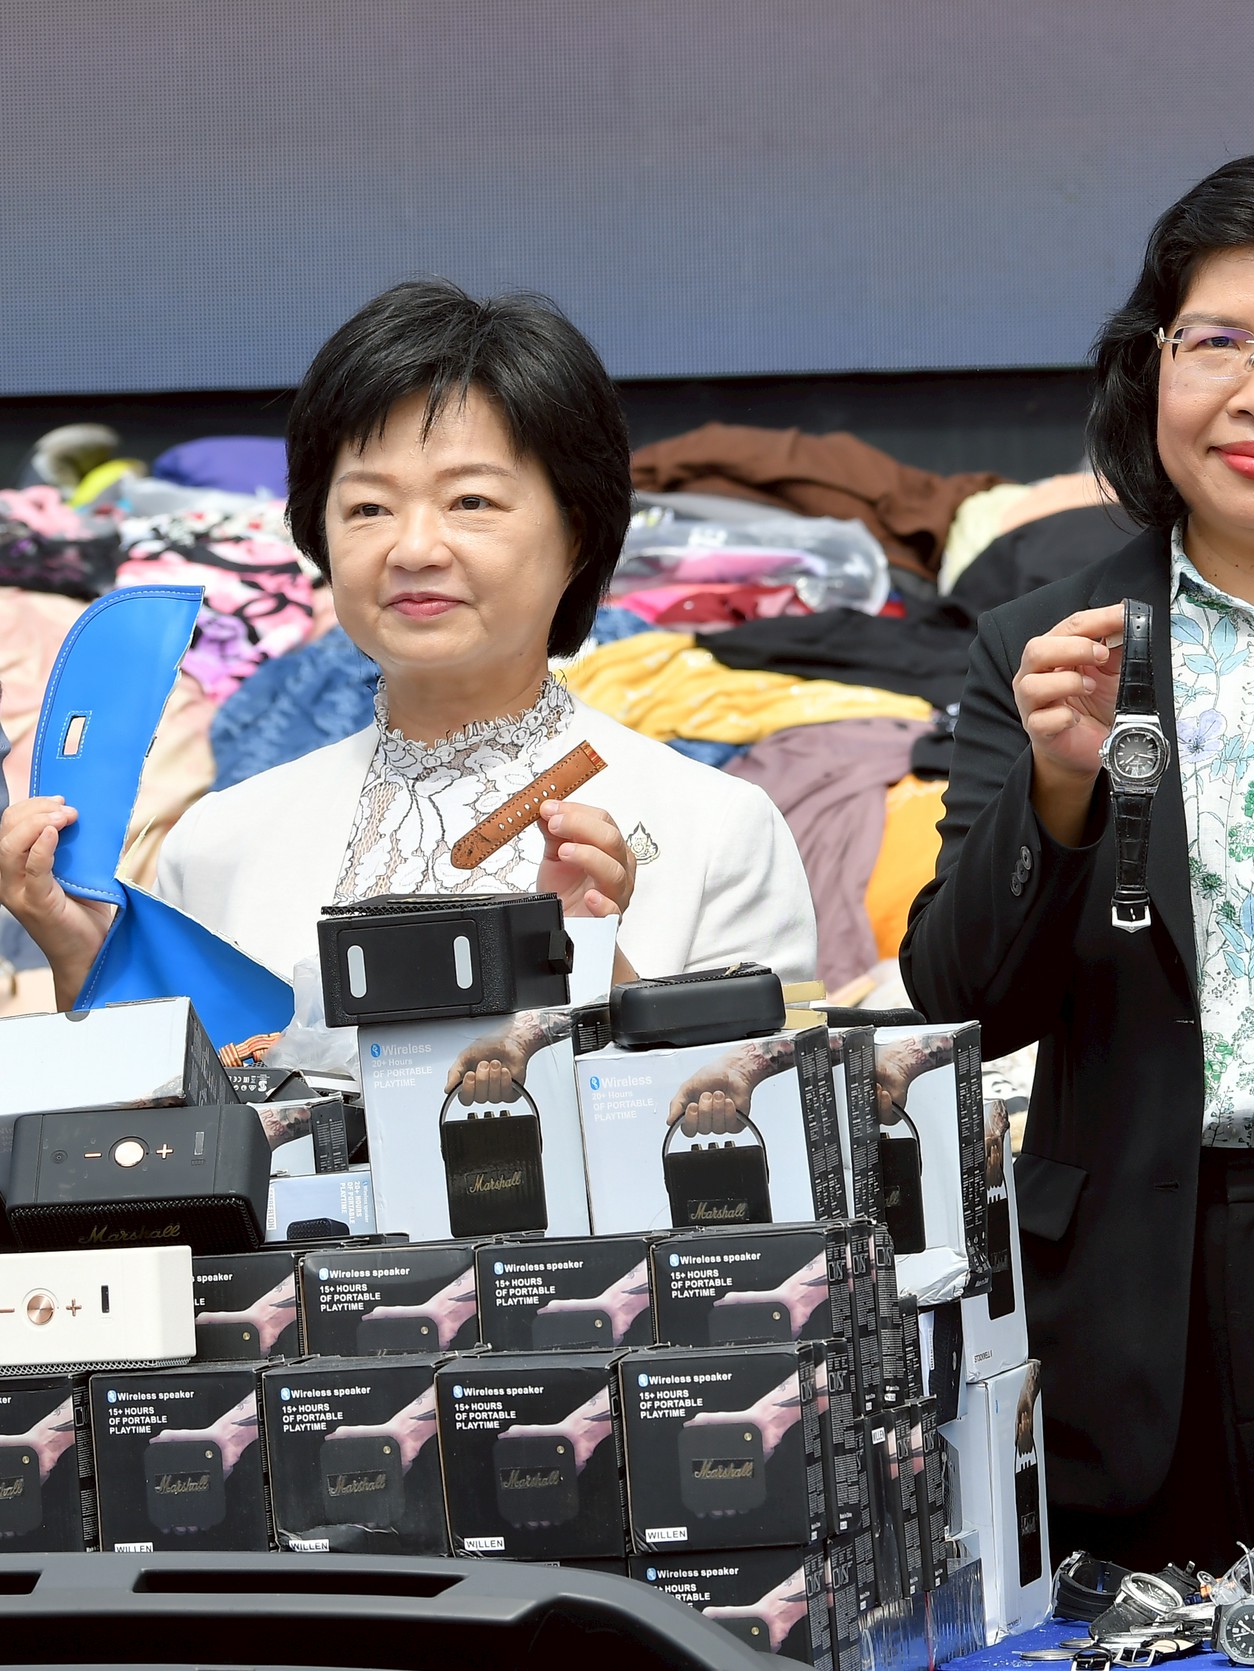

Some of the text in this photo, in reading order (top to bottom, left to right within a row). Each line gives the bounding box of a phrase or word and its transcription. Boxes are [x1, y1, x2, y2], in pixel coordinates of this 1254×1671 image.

[381, 1042, 432, 1056] Wireless
[372, 1057, 412, 1068] 20+ Hours
[373, 1066, 432, 1078] OF PORTABLE
[374, 1078, 416, 1089] PLAYTIME
[601, 1074, 652, 1089] Wireless
[591, 1090, 633, 1100] 20+ Hours
[593, 1098, 654, 1110] OF PORTABLE
[594, 1110, 637, 1122] PLAYTIME
[469, 1171, 522, 1194] Marshall
[347, 1192, 356, 1224] PORTABLE
[690, 1201, 746, 1220] Marshall
[78, 1224, 181, 1244] Marshall
[680, 1252, 761, 1266] Wireless speaker
[504, 1260, 584, 1273] Wireless speaker
[196, 1272, 233, 1283] speaker
[329, 1267, 410, 1279] Wireless speaker
[670, 1269, 719, 1280] 15+ HOURS
[319, 1283, 367, 1293] 15+ HOURS
[495, 1277, 543, 1288] 15+ HOURS
[671, 1277, 733, 1289] OF PORTABLE
[495, 1285, 556, 1297] OF PORTABLE
[671, 1288, 716, 1299] PLAYTIME
[320, 1292, 381, 1302] OF PORTABLE
[496, 1296, 539, 1306] PLAYTIME
[320, 1302, 364, 1312] PLAYTIME
[649, 1372, 733, 1386] Wireless speaker
[117, 1390, 195, 1401] Wireless speaker
[291, 1386, 371, 1399] Wireless speaker
[463, 1385, 544, 1397] Wireless speaker
[639, 1389, 689, 1400] 15+ HOURS
[282, 1403, 330, 1414] 15+ HOURS
[454, 1402, 503, 1412] 15+ HOURS
[640, 1398, 703, 1410] OF PORTABLE
[108, 1406, 155, 1416] 15+ HOURS
[455, 1410, 516, 1421] OF PORTABLE
[640, 1408, 686, 1419] PLAYTIME
[109, 1415, 168, 1425] OF PORTABLE
[282, 1411, 344, 1423] OF PORTABLE
[109, 1425, 152, 1435] PLAYTIME
[283, 1422, 327, 1433] PLAYTIME
[456, 1420, 500, 1430] PLAYTIME
[694, 1460, 754, 1479] Marshall
[154, 1474, 210, 1495] Marshall
[502, 1469, 560, 1489] Marshall
[330, 1474, 387, 1496] Marshall
[647, 1530, 686, 1540] WILLEN
[291, 1541, 328, 1551] WILLEN
[466, 1539, 503, 1549] WILLEN
[656, 1566, 739, 1579] Wireless speaker
[664, 1583, 697, 1593] HOURS
[671, 1592, 711, 1602] RTABLE
